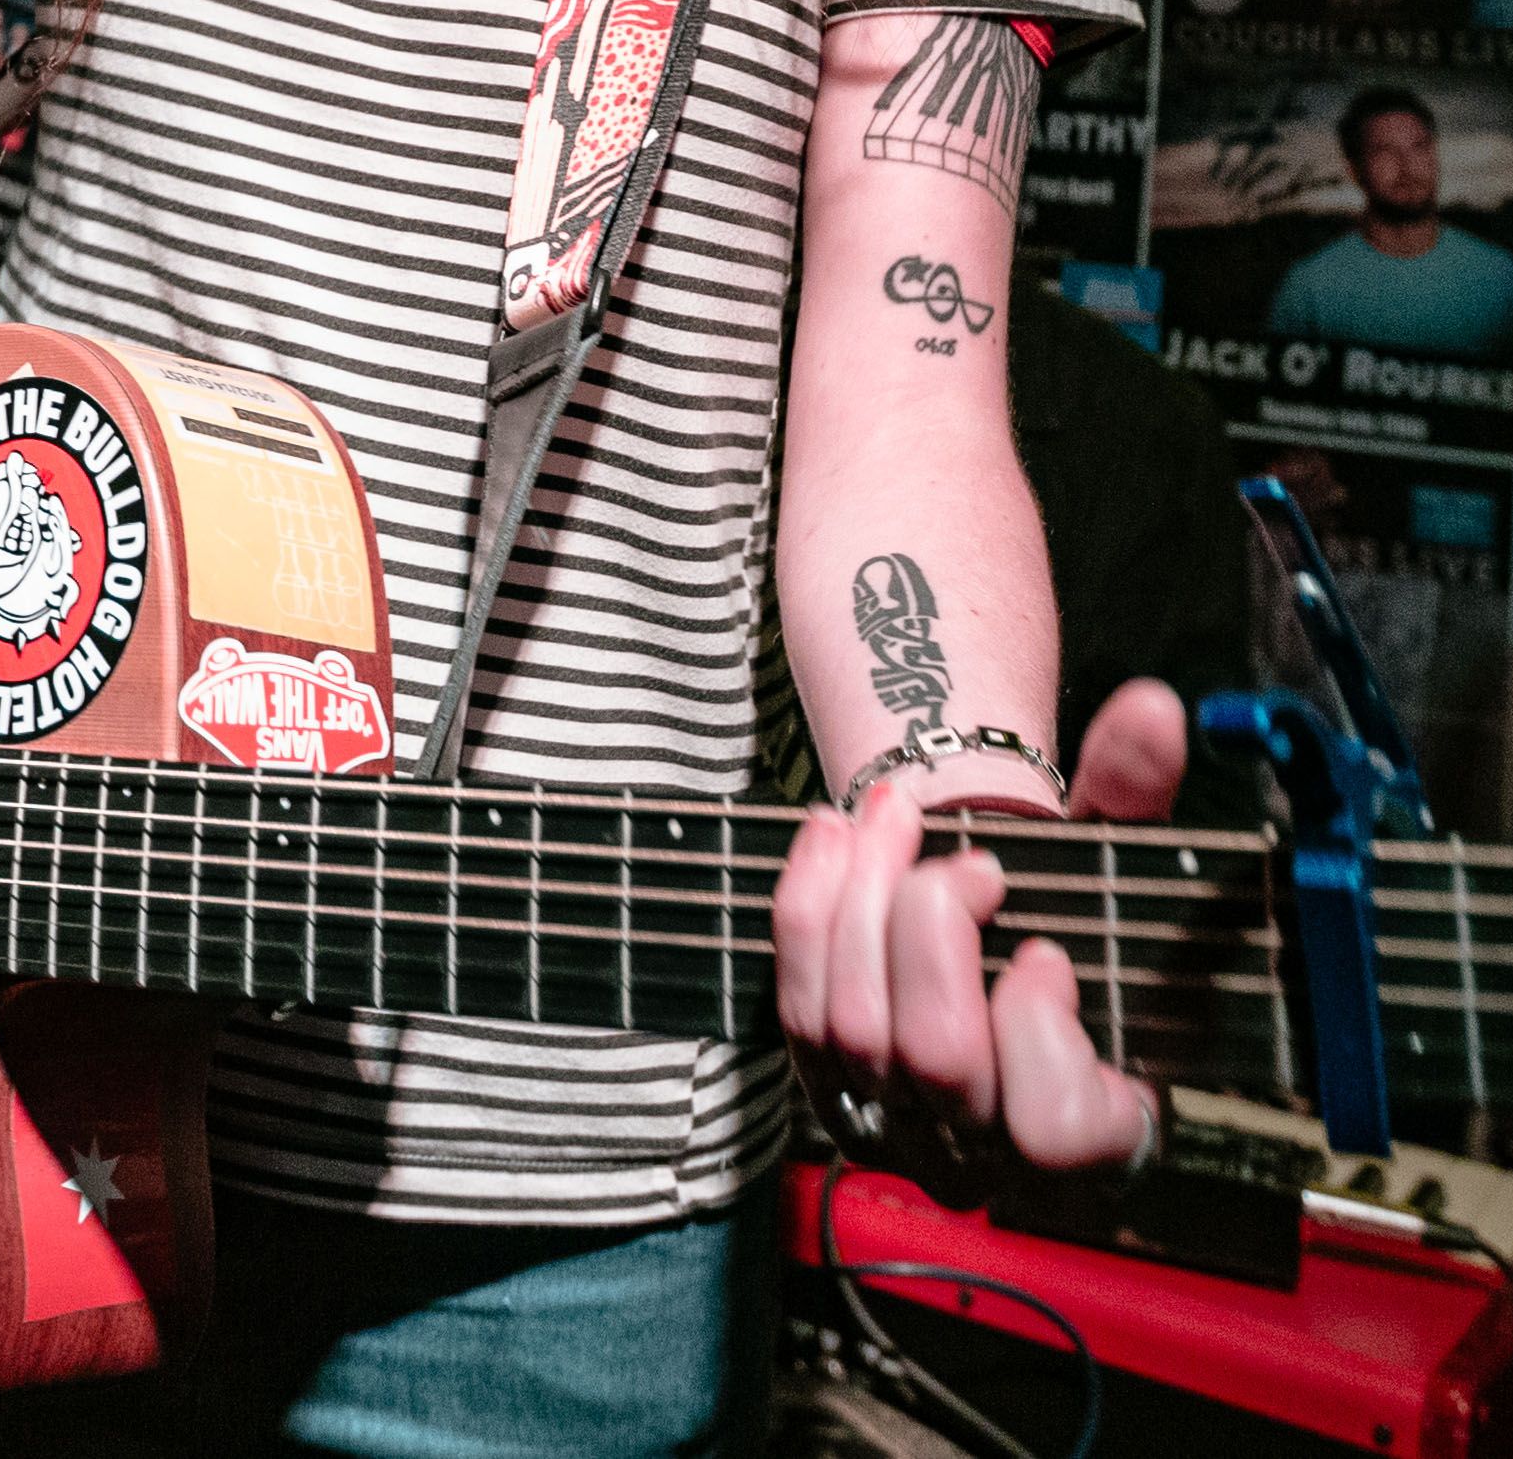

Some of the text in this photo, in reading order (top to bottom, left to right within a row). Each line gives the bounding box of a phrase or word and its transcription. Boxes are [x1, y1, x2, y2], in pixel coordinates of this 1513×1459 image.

[160, 367, 213, 393] GUEST
[1162, 328, 1271, 380] JACK
[61, 394, 148, 642] BULLDOG
[267, 672, 322, 729] THE
[254, 725, 329, 772] VANS
